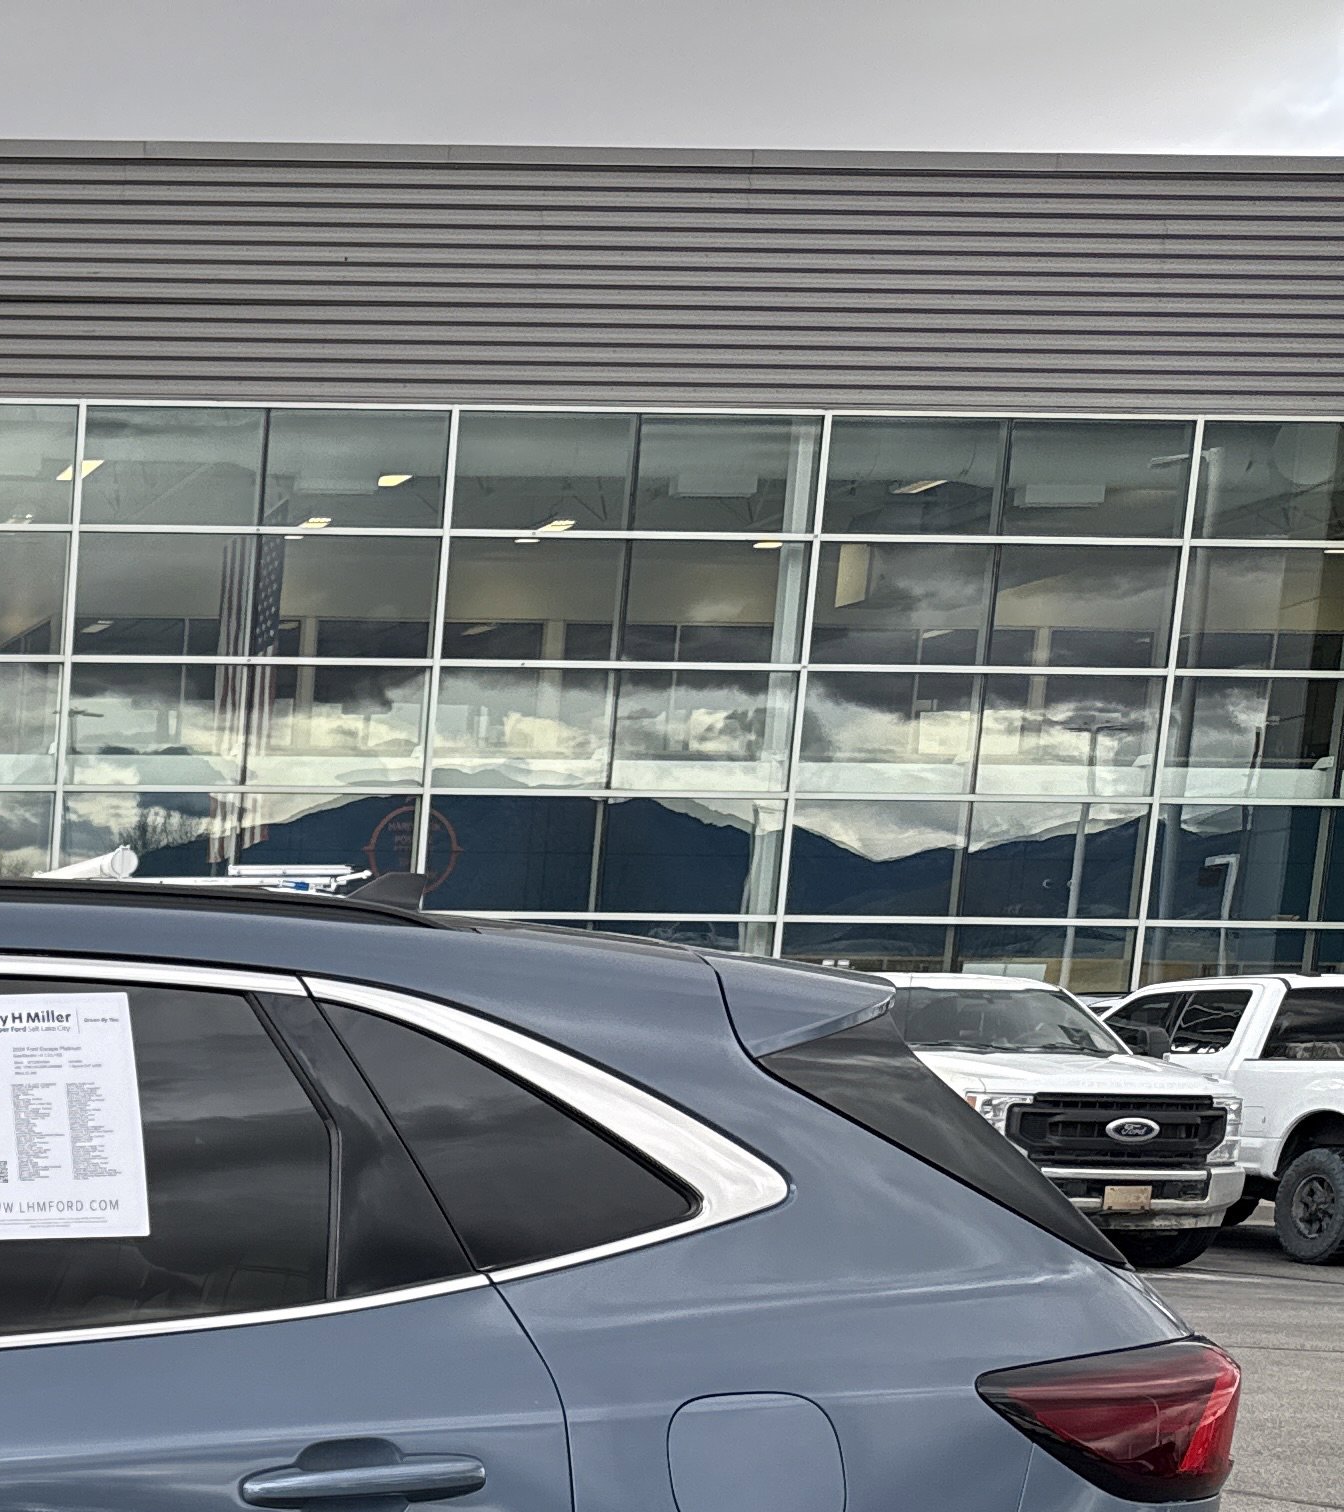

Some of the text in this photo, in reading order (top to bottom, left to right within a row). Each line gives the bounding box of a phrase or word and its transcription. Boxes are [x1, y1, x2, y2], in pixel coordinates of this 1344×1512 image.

[12, 1012, 23, 1024] H
[27, 1010, 72, 1023] Miller
[10, 1025, 27, 1033] Ford
[57, 1024, 71, 1033] City
